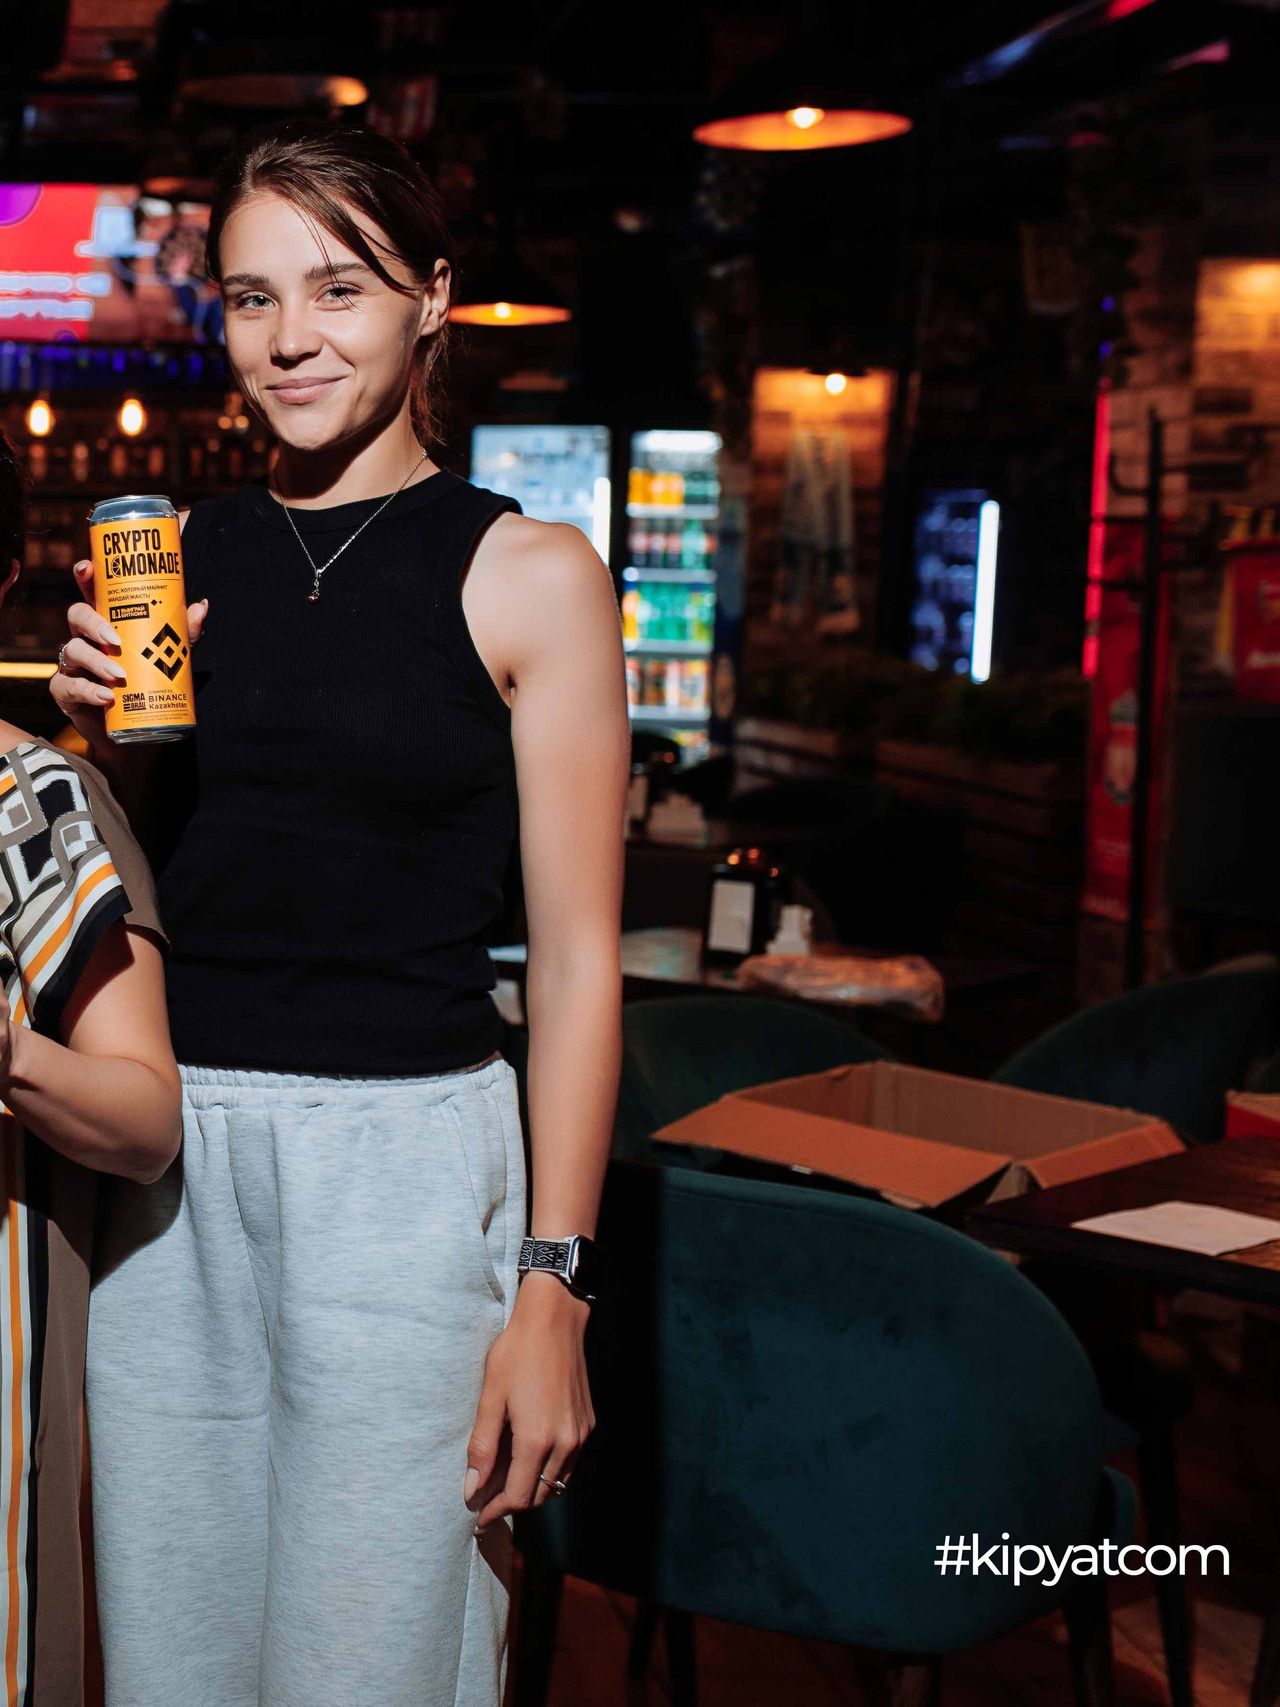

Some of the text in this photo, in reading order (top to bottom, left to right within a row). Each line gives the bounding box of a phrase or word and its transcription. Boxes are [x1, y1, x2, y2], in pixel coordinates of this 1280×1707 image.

[103, 528, 162, 556] CRYPTO
[111, 609, 121, 619] 0.1
[122, 692, 146, 703] SIGMA
[148, 694, 187, 702] BINANCE
[149, 702, 188, 710] Kazakhstan
